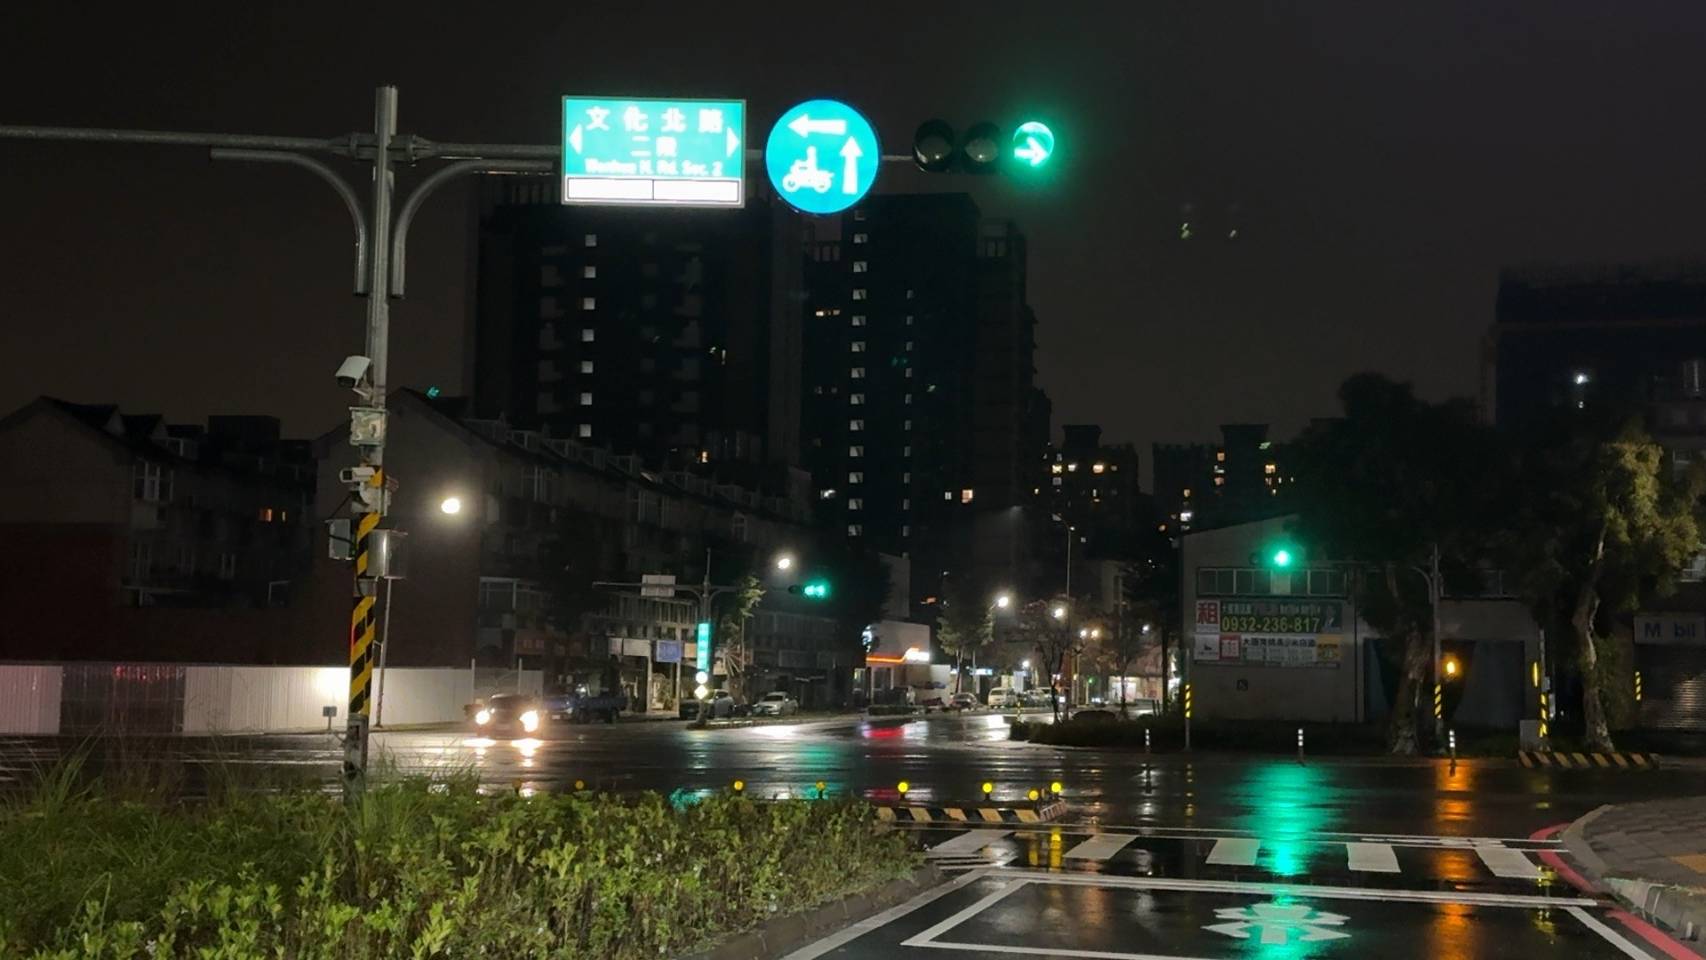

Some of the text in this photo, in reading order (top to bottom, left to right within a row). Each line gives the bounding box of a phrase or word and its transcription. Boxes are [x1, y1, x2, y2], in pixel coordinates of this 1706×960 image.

[585, 105, 723, 133] 文化北
[630, 136, 677, 157] 二
[1198, 602, 1218, 625] 租
[1221, 616, 1320, 632] 0932-236-817
